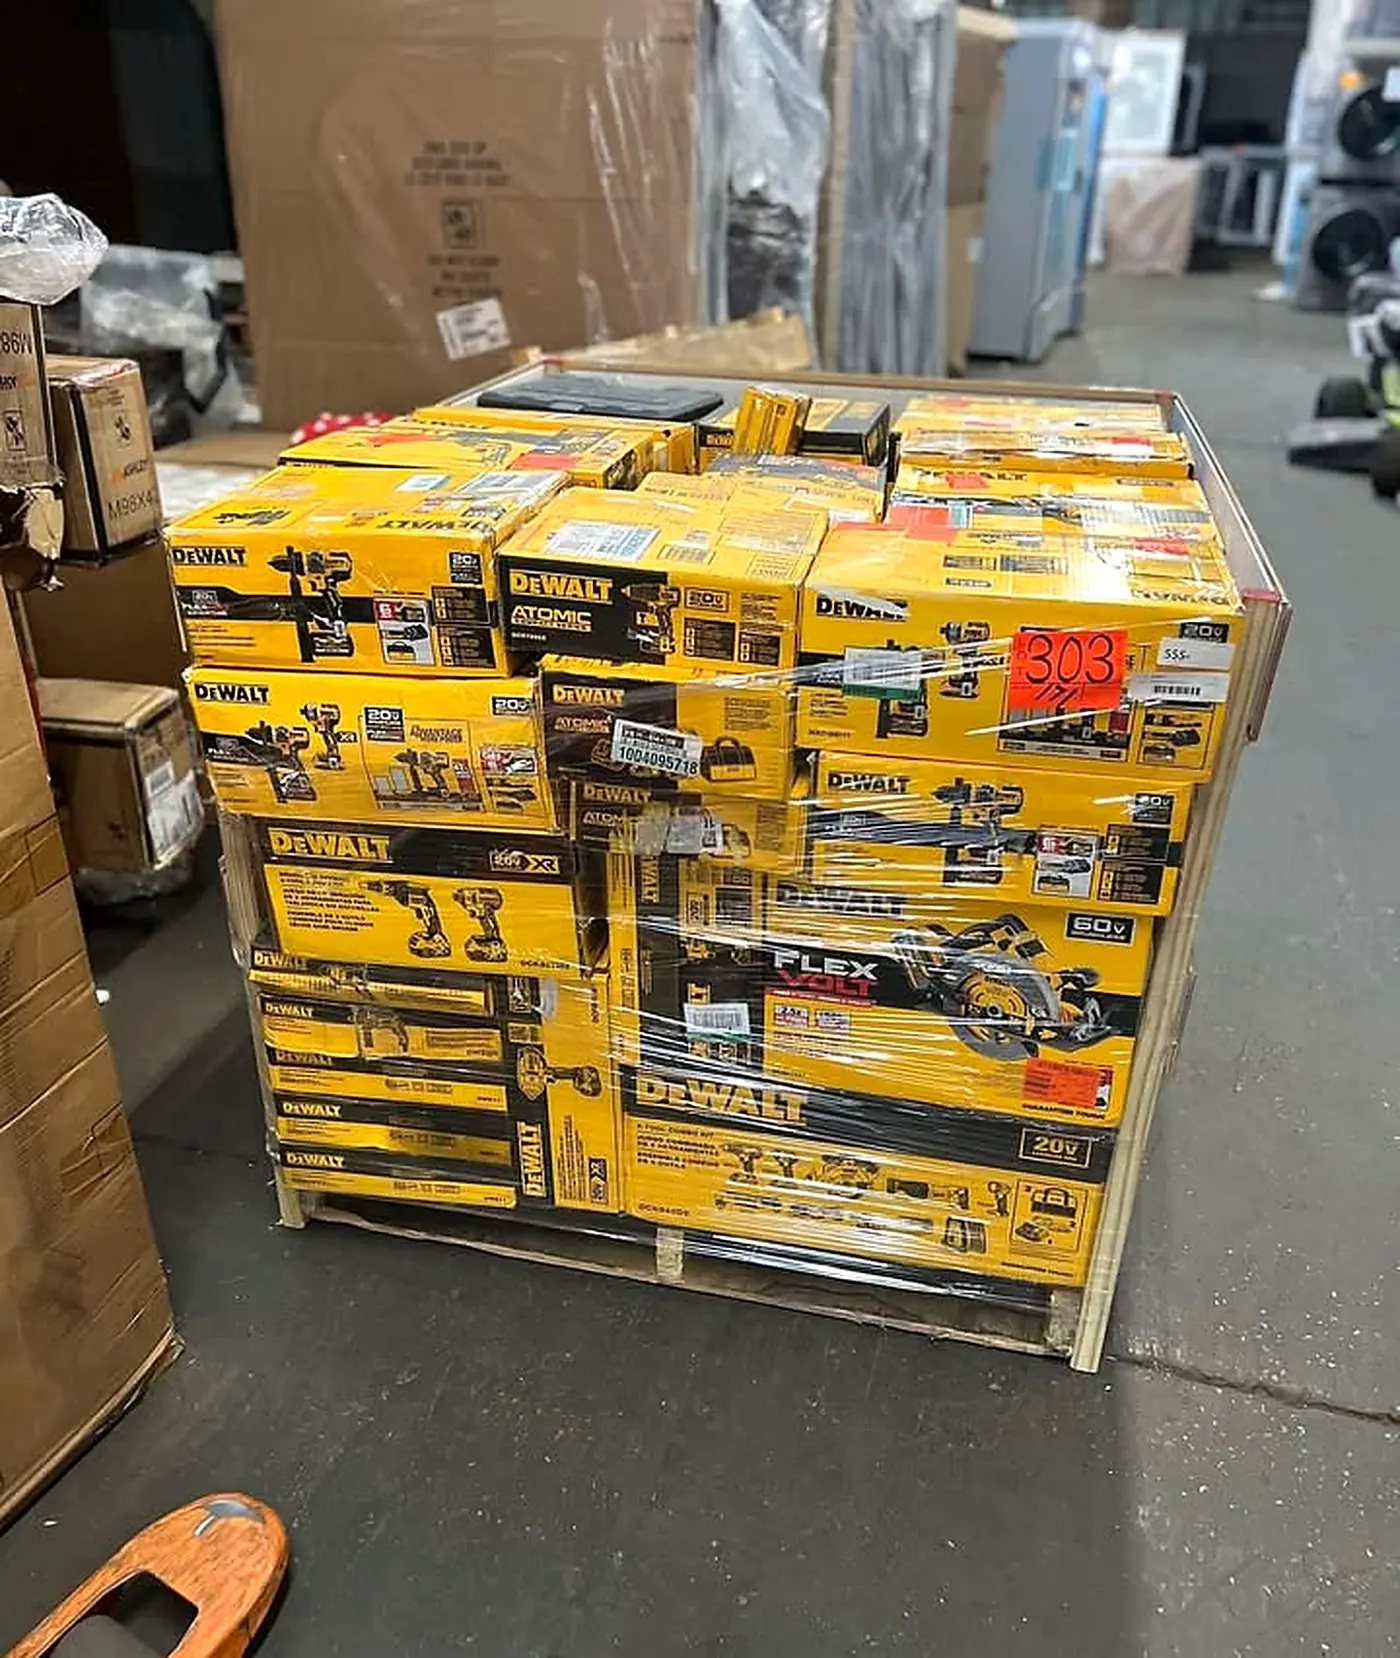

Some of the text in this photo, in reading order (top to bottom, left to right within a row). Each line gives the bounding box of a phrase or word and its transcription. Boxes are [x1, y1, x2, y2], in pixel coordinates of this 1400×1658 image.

[172, 548, 246, 565] DEWALT
[509, 573, 613, 601] DEWALT
[511, 605, 592, 624] ATOMIC
[1026, 634, 1114, 684] 303
[195, 684, 269, 702] DEWALT
[553, 686, 625, 705] DEWALT
[828, 772, 910, 793] DEWALT
[269, 830, 391, 861] DEWALT
[530, 857, 558, 871] XR
[1073, 917, 1126, 935] 60V
[774, 950, 879, 981] FLEX
[775, 967, 881, 997] VOLT
[264, 1001, 314, 1017] DEWALT
[637, 1073, 808, 1124] DEWALT
[282, 1102, 342, 1118] DEWALT
[1033, 1134, 1080, 1155] 20V
[285, 1152, 346, 1168] DEWALT
[518, 1121, 546, 1196] DEWALT
